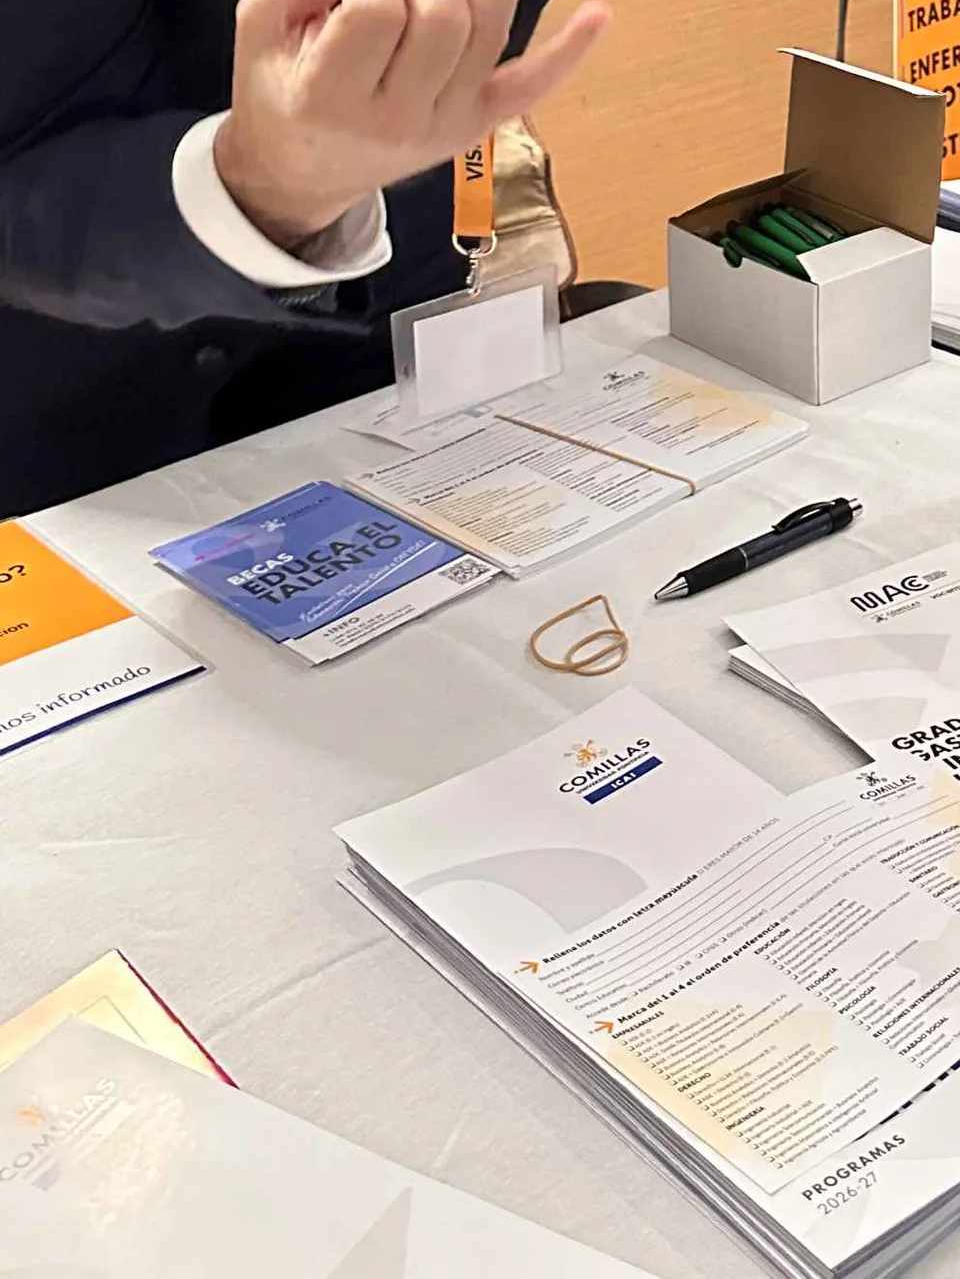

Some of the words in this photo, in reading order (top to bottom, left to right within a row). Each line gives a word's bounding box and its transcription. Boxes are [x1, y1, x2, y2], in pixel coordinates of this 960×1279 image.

[227, 552, 294, 587] BECAS
[241, 540, 354, 597] EDUCA
[356, 522, 398, 542] EL
[257, 534, 402, 606] TALENTO
[38, 666, 151, 715] informado
[560, 739, 651, 793] COMILLAS
[611, 772, 636, 788] ICAI
[860, 775, 916, 800] COMILLAS
[541, 945, 577, 964] Rellena
[576, 938, 592, 947] los
[589, 924, 616, 940] datos
[615, 915, 634, 926] con
[632, 902, 654, 916] letra
[654, 873, 698, 904] mayúscula
[754, 928, 790, 955] EDUCACIÓN
[616, 1006, 647, 1023] Marca
[644, 996, 662, 1008] del
[667, 987, 678, 996] al
[684, 977, 696, 986] el
[694, 961, 722, 980] orden
[720, 953, 733, 964] de
[730, 920, 780, 956] preferencia
[805, 967, 838, 991] FILOSOFÍA
[838, 986, 876, 1014] PSICOLOGÍA
[873, 1008, 911, 1038] RELACIONES
[898, 1033, 927, 1056] TRABAJO
[926, 1016, 949, 1034] SOCIAL
[677, 1072, 711, 1093] DERECHO
[0, 1078, 117, 1184] COMILLAS
[802, 1134, 906, 1201] PROGRAMAS
[817, 1172, 878, 1215] 2026-27
